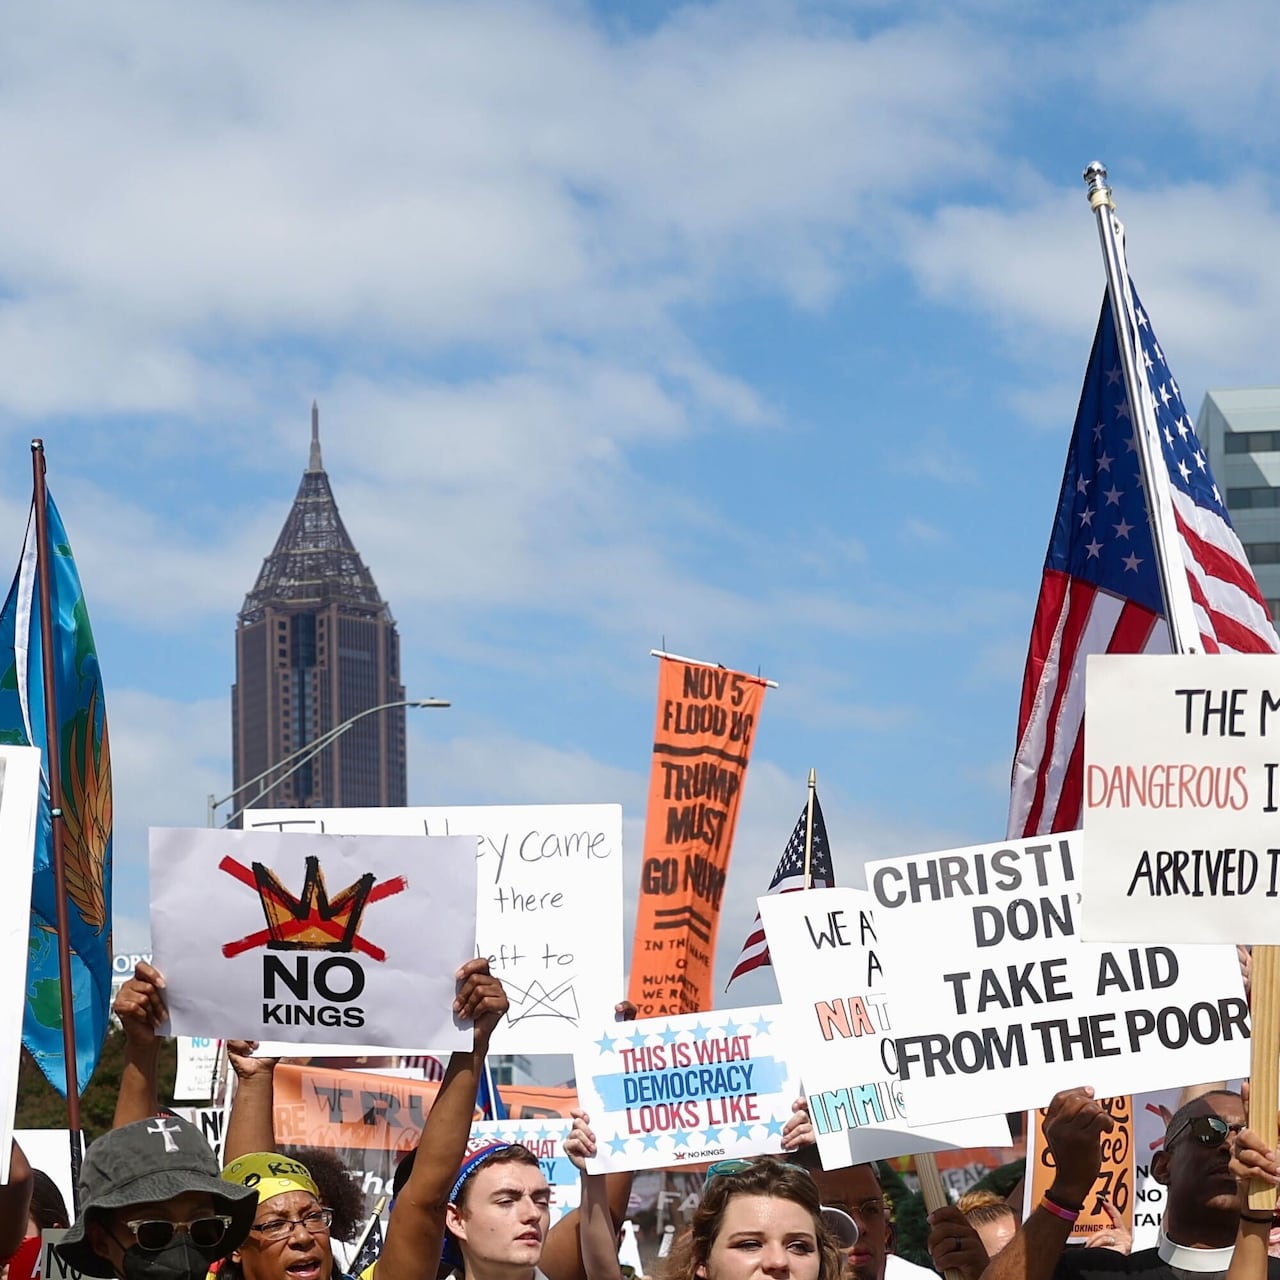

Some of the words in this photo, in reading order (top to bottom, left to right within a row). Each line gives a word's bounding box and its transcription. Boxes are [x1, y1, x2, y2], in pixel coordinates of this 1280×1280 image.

[683, 666, 729, 701] NOV
[730, 675, 747, 707] 5
[662, 699, 729, 738] FLOOD
[1174, 688, 1248, 738] THE
[661, 761, 740, 809] TRUMP
[1086, 763, 1250, 812] DANGEROUS
[519, 829, 612, 863] came
[665, 803, 728, 849] MUST
[641, 856, 679, 897] GO
[871, 839, 1075, 909] CHRISTI
[1126, 848, 1259, 898] ARRIVED
[493, 886, 564, 914] there
[972, 891, 1084, 949] DON'
[644, 940, 664, 951] IN
[804, 910, 850, 950] WE
[540, 943, 575, 968] to
[263, 955, 366, 1002] NO
[642, 989, 664, 1000] WE
[943, 957, 1074, 1016] TAKE
[1095, 945, 1180, 997] AID
[263, 1003, 366, 1028] KINGS
[815, 993, 890, 1041] NAT
[619, 1046, 667, 1075] THIS
[671, 1042, 692, 1069] IS
[693, 1035, 752, 1066] WHAT
[895, 1023, 1029, 1081] FROM
[1030, 1012, 1122, 1064] THE
[1124, 996, 1252, 1054] POOR
[623, 1064, 754, 1104] DEMOCRACY
[625, 1100, 700, 1135] LOOKS
[706, 1092, 760, 1126] LIKE
[687, 1151, 701, 1159] NO
[700, 1149, 726, 1158] KINGS
